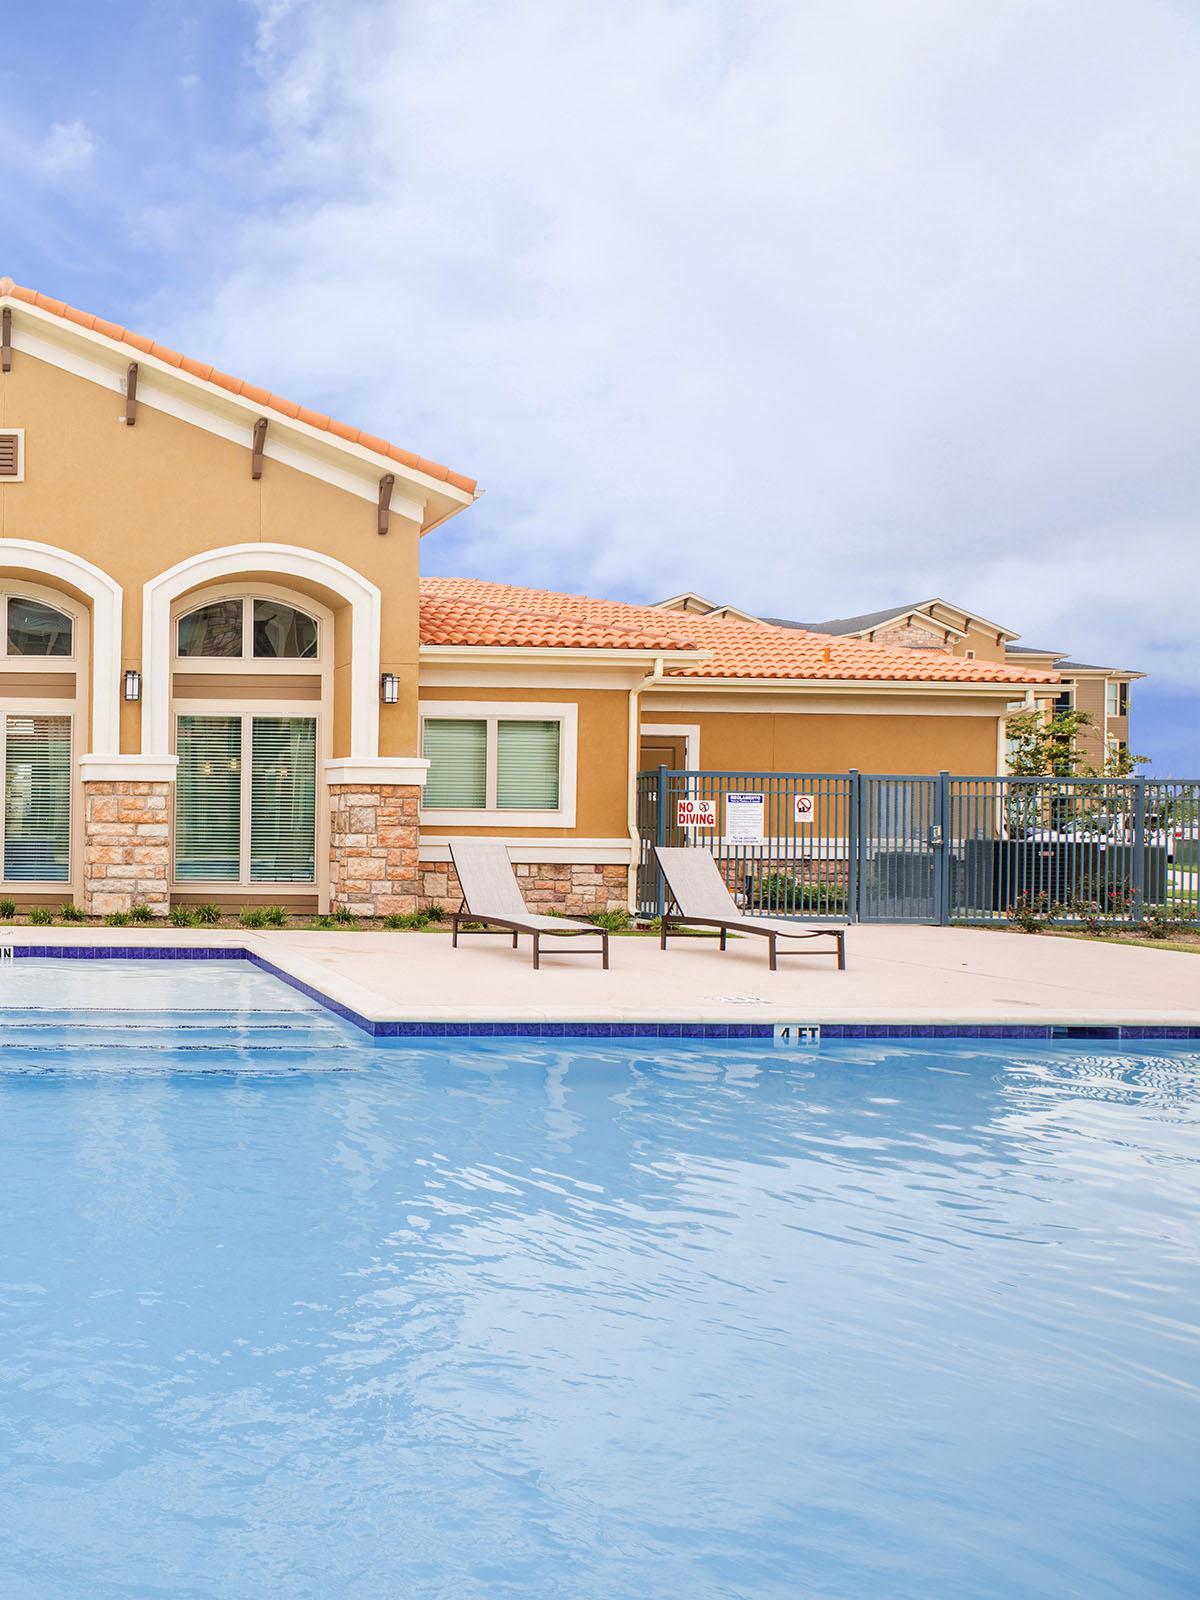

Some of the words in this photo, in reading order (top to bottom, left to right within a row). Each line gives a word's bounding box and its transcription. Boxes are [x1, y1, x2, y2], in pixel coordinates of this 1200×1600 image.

[678, 801, 694, 813] NO
[678, 813, 715, 825] DIVING
[798, 1027, 819, 1041] FT
